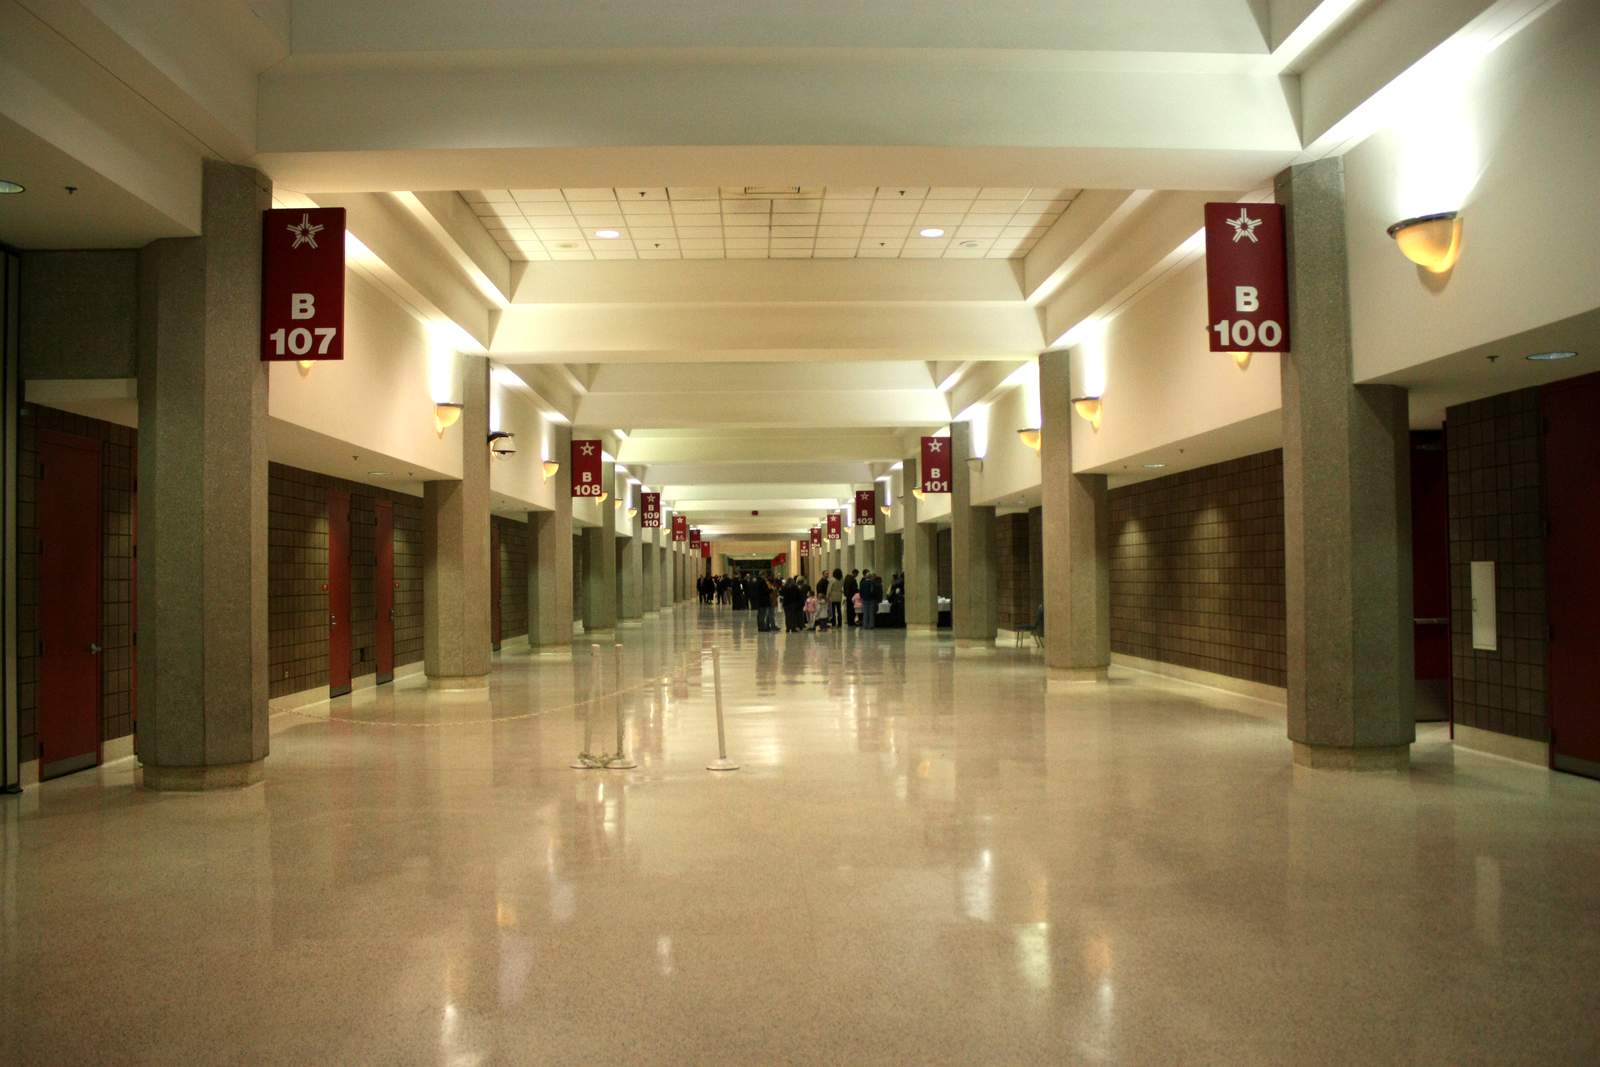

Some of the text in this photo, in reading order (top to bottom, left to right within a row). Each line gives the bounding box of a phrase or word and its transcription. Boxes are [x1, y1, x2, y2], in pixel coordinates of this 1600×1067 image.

[1235, 286, 1259, 312] B
[291, 293, 316, 320] B
[1213, 319, 1282, 347] 100
[269, 327, 337, 355] 107
[582, 471, 592, 482] B
[931, 468, 941, 479] B
[574, 484, 601, 496] 108
[924, 480, 948, 492] 101
[648, 504, 654, 512] B
[643, 512, 659, 520] 109
[644, 519, 659, 527] 110
